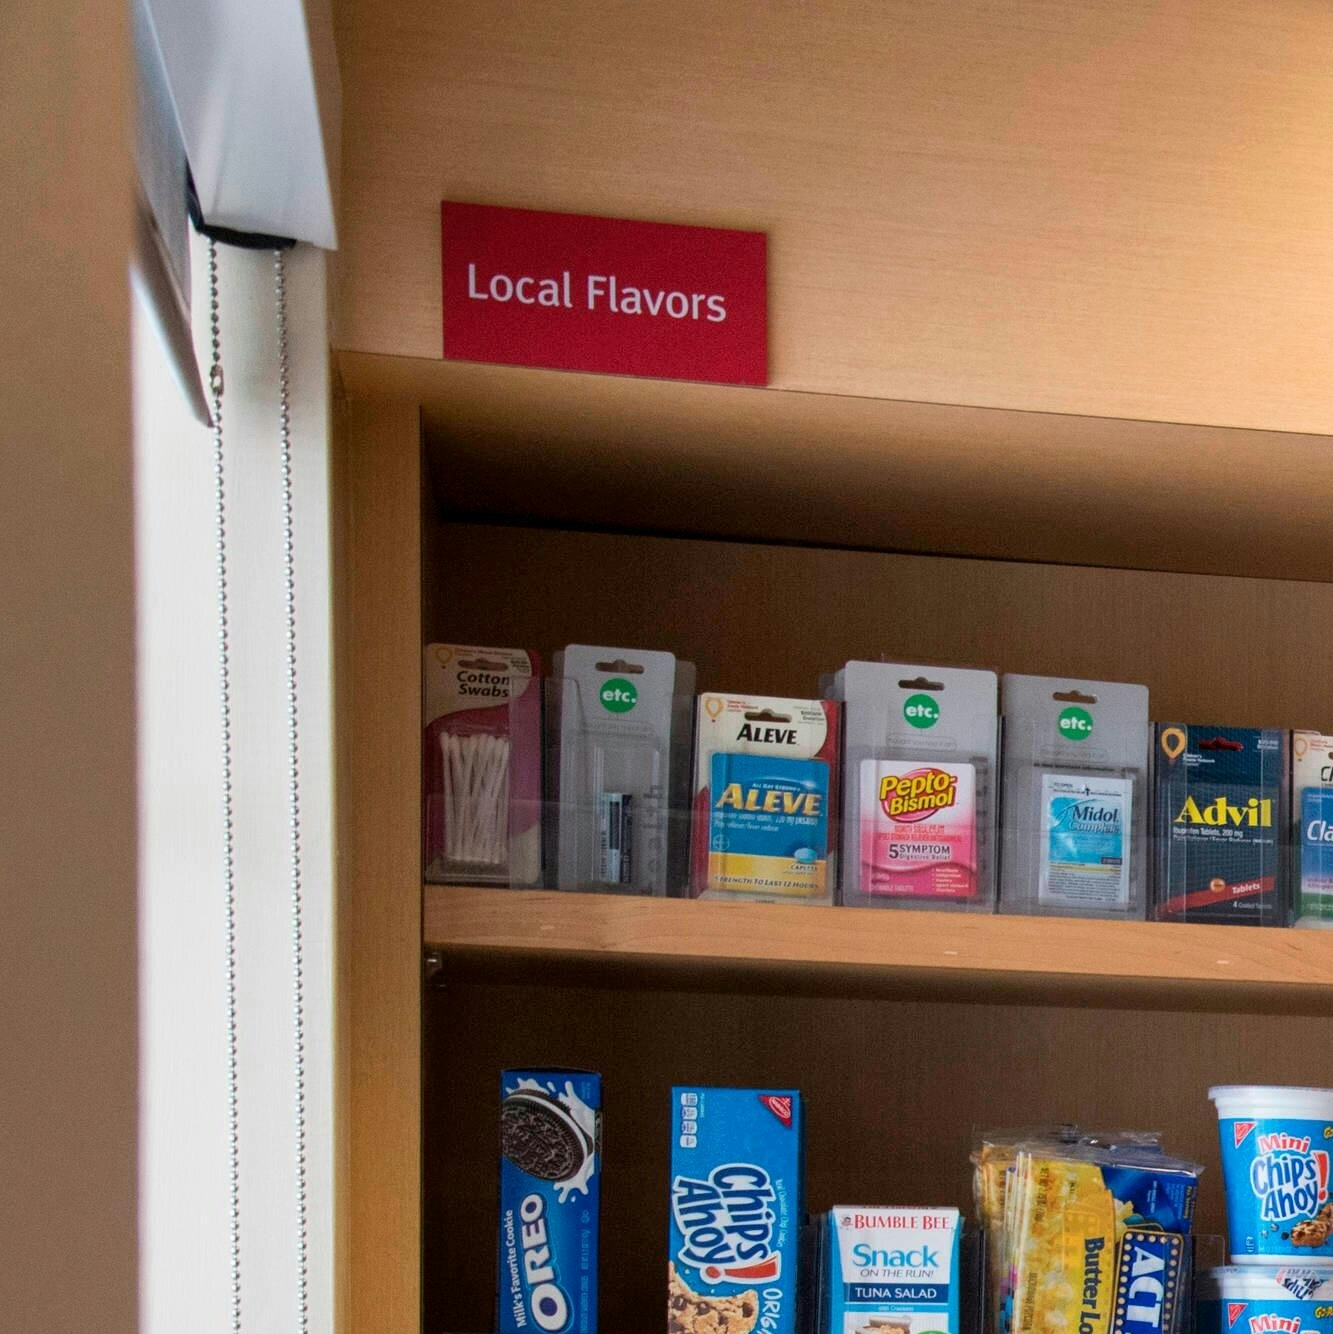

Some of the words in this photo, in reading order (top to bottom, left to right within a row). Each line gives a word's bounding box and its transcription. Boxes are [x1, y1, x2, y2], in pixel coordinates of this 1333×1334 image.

[468, 263, 572, 308] Local
[587, 275, 727, 322] Flavors
[457, 671, 510, 685] Cotton
[458, 683, 510, 698] Swabs
[603, 687, 637, 704] etc.
[736, 724, 797, 745] ALEVE
[880, 772, 958, 801] Pepto-
[715, 782, 821, 817] ALEVE
[889, 787, 954, 817] Bismol
[1072, 804, 1120, 823] Midol
[1174, 795, 1254, 828] Advil
[888, 843, 899, 859] 5
[900, 844, 951, 855] SYMPTOM
[1259, 1133, 1311, 1153] Mini
[503, 1209, 516, 1246] Cookie
[854, 1214, 918, 1229] BUMBLE
[921, 1215, 950, 1230] BEE
[521, 1193, 569, 1332] OREO
[852, 1243, 939, 1268] Snack
[860, 1269, 879, 1278] ON
[881, 1269, 903, 1278] THE
[1081, 1236, 1106, 1309] Butter
[855, 1287, 891, 1298] TUNA
[895, 1288, 937, 1299] SALAD
[1126, 1246, 1166, 1329] ACT
[1250, 1314, 1301, 1333] Mini
